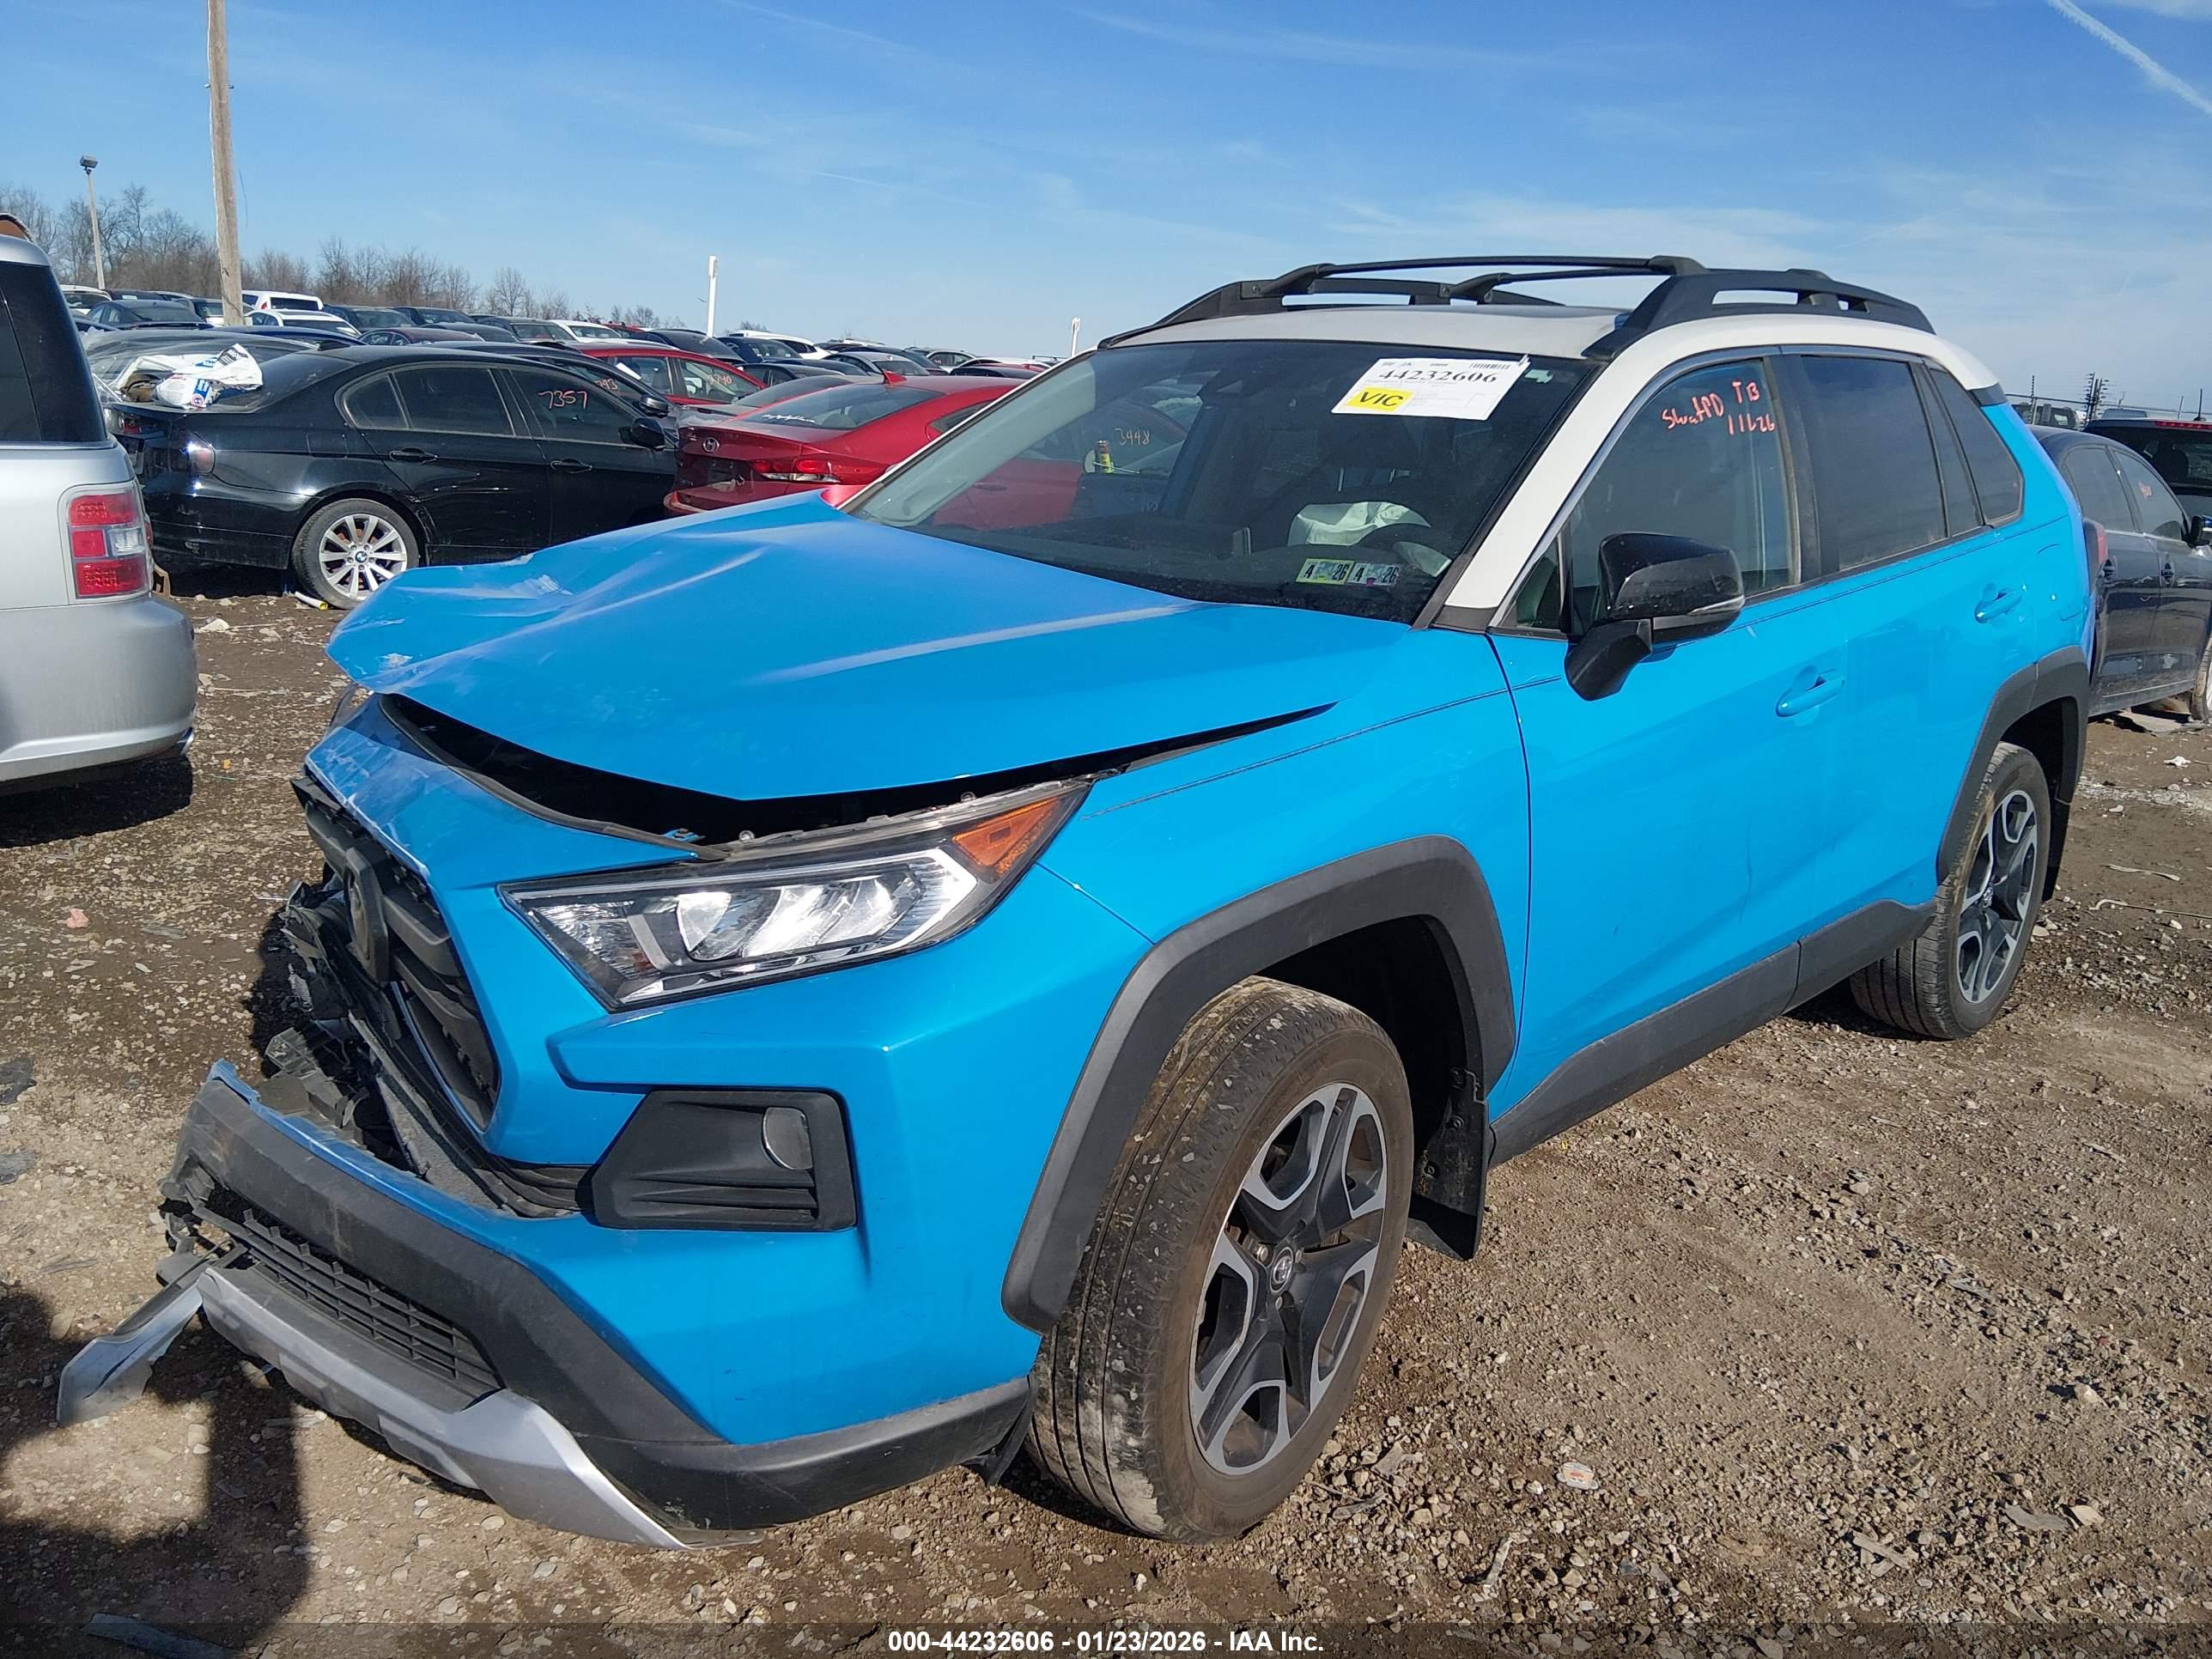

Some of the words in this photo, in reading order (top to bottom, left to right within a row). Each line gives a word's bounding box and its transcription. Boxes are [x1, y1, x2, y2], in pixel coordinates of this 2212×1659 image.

[1378, 369, 1498, 384] 44232606
[538, 390, 588, 410] 7357
[1359, 392, 1404, 407] VIC
[1114, 428, 1151, 447] 3448
[1333, 563, 1349, 581] 26
[1382, 566, 1400, 583] 26
